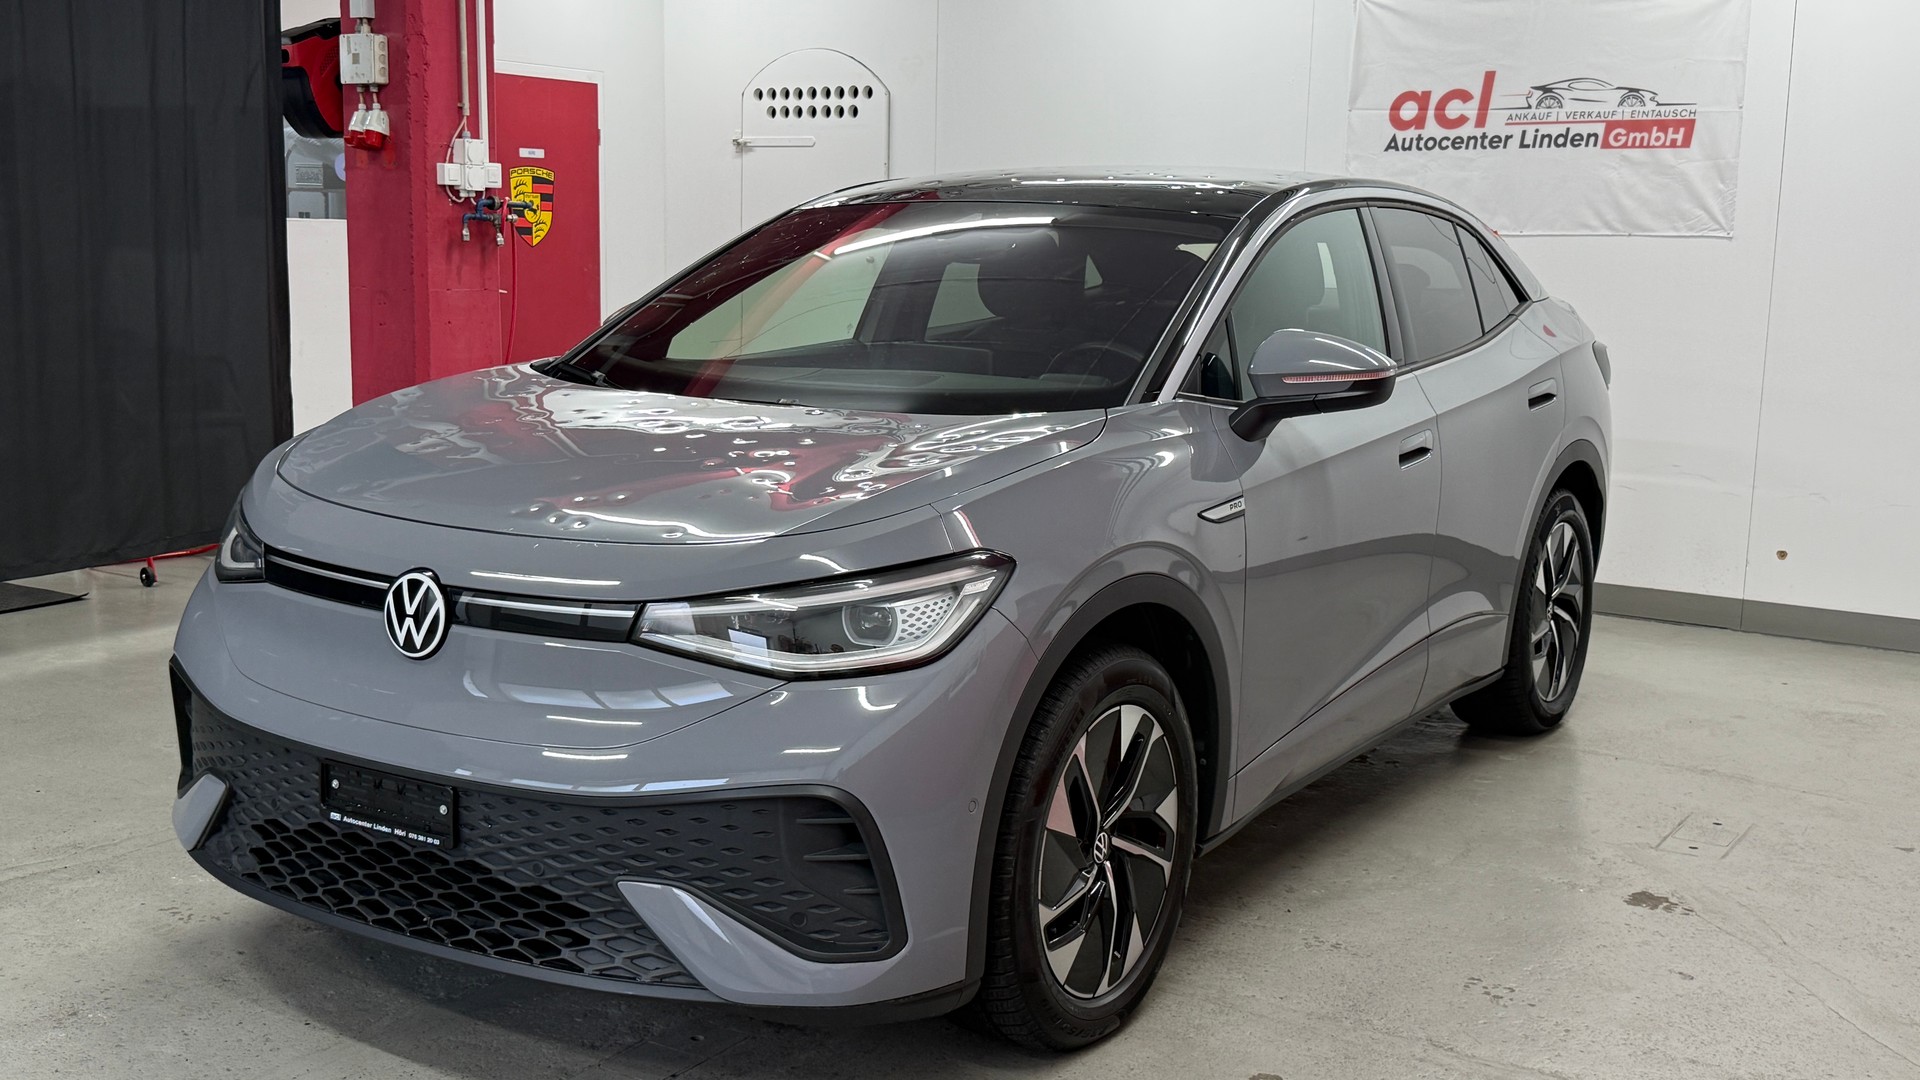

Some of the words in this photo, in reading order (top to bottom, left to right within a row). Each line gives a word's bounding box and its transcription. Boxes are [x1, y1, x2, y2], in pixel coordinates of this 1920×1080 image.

[1388, 70, 1497, 132] acl
[1506, 111, 1553, 122] ANKAUF
[1565, 110, 1618, 120] VERKAUF
[1630, 108, 1697, 119] EINTAUSCH
[1383, 132, 1514, 152] Autocenter
[1518, 127, 1599, 149] Linden
[1608, 127, 1686, 147] GmbH
[510, 167, 553, 179] PORSCHE
[1229, 501, 1243, 511] PRO
